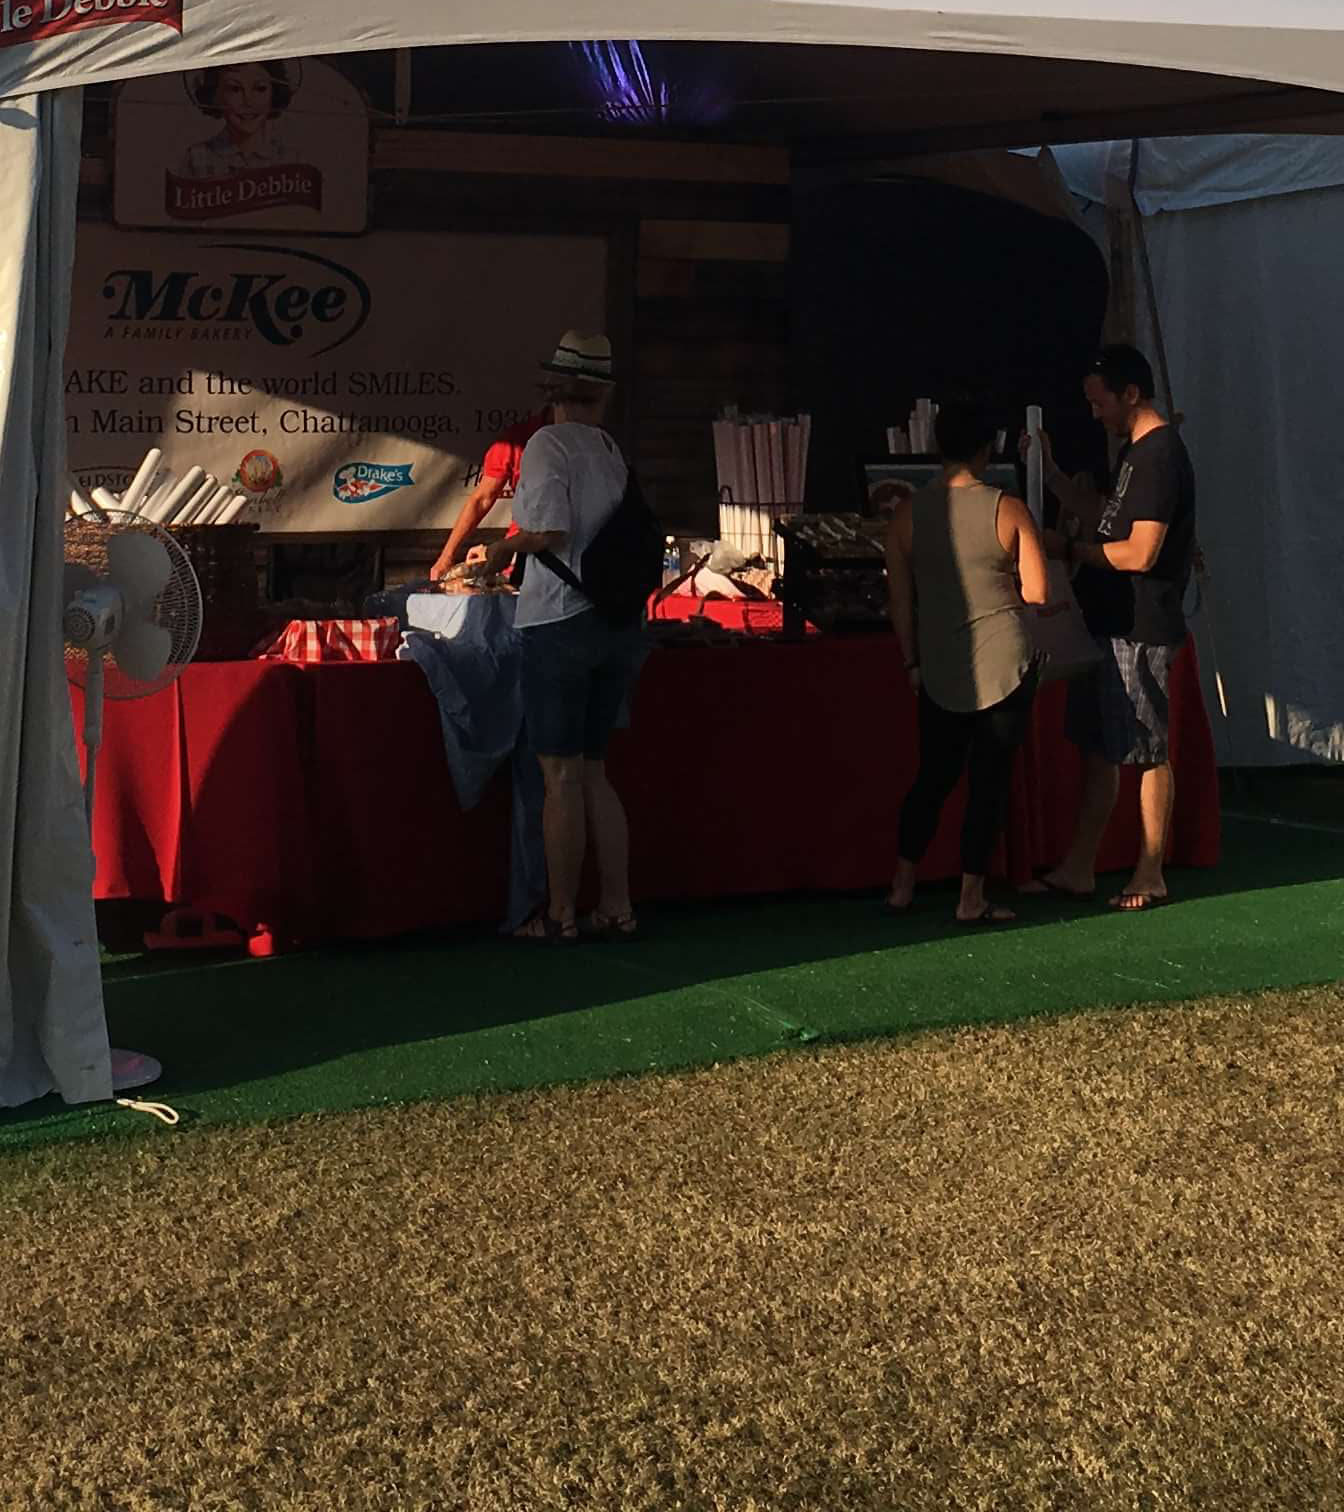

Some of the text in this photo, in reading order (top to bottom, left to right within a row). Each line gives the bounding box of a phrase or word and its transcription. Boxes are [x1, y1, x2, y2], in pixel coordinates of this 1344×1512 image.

[175, 172, 313, 209] Little Debbie
[103, 270, 348, 345] McKee
[123, 326, 182, 339] FAMILY
[189, 326, 255, 339] BAKERY
[139, 370, 194, 394] and
[206, 370, 255, 395] the
[261, 372, 338, 395] world
[93, 409, 162, 434] Main
[175, 409, 268, 436] Street,
[280, 409, 461, 439] Chattanooga,
[357, 464, 404, 482] Drake's
